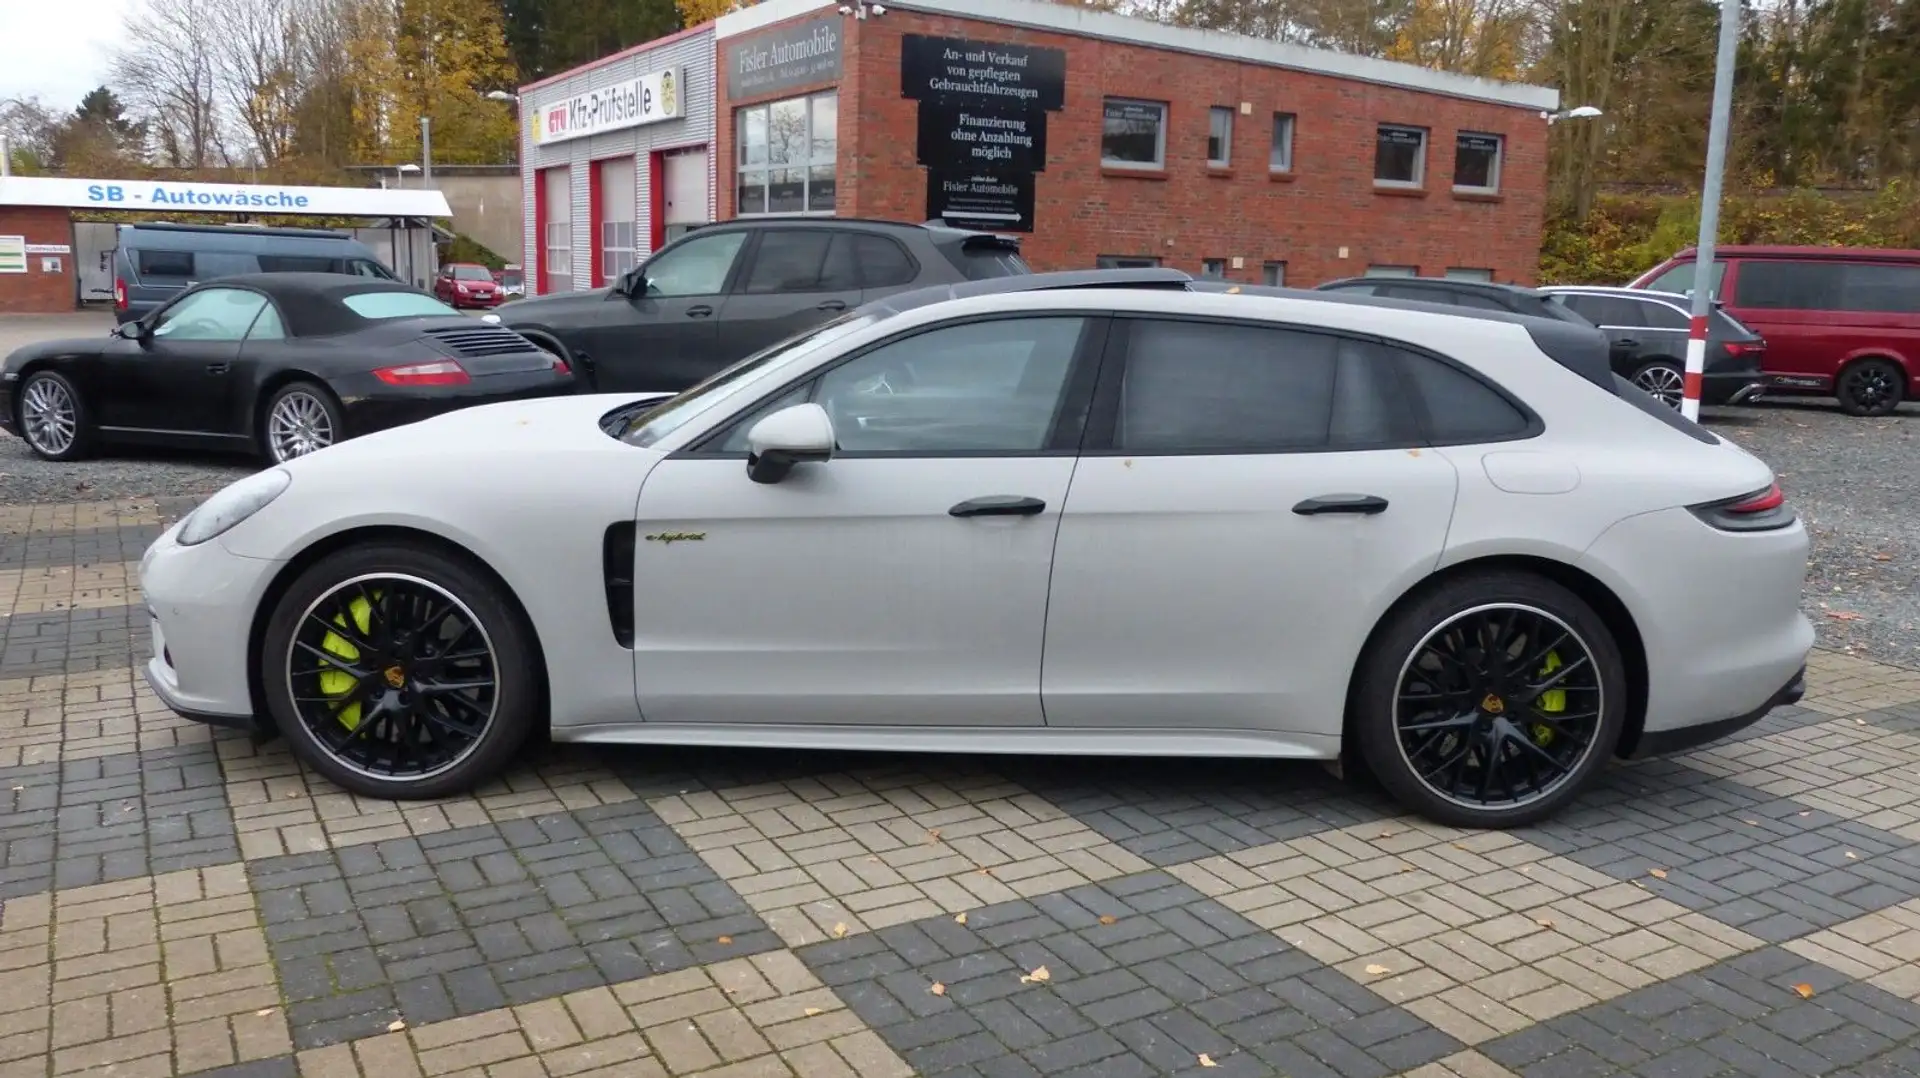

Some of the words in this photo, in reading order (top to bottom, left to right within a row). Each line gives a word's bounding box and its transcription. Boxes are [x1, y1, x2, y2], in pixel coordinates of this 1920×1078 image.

[739, 45, 768, 74] Fisler
[770, 25, 837, 67] Automobile
[943, 47, 963, 60] An-
[965, 50, 985, 63] und
[988, 52, 1029, 67] Verkauf
[947, 66, 966, 76] von
[968, 66, 1021, 82] gepflegten
[929, 77, 1038, 99] Gebrauchtfahrzeugen
[569, 80, 652, 131] Kfz-Prüfstelle
[959, 113, 1027, 132] Finanzierung
[951, 128, 977, 142] ohne
[979, 131, 1033, 148] Anzahlung
[971, 146, 1012, 160] möglich
[87, 185, 124, 202] SB
[151, 187, 308, 208] Autowäsche
[971, 183, 1019, 196] Automobile
